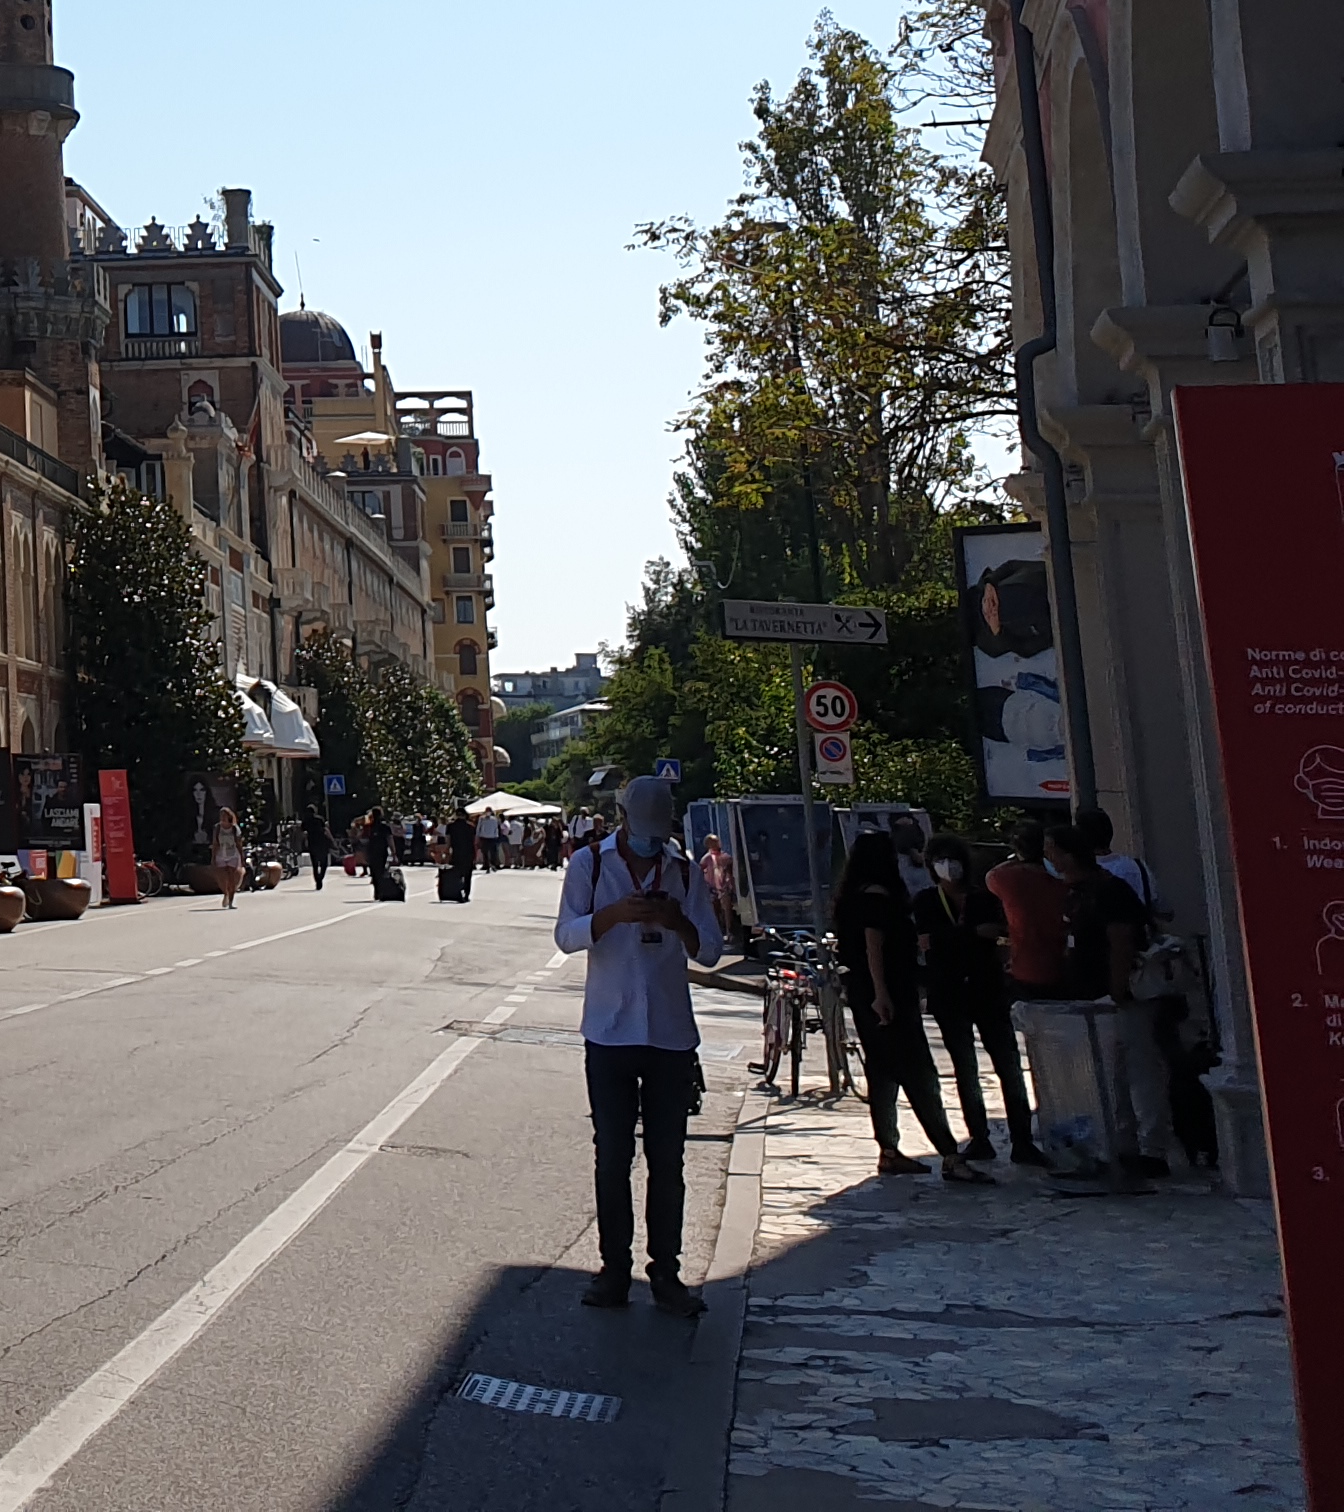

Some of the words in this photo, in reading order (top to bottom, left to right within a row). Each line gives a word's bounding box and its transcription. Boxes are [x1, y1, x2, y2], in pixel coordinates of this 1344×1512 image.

[1247, 647, 1306, 661] Norme
[1309, 647, 1326, 661] di
[1249, 664, 1284, 678] Anti
[1251, 682, 1286, 696] Anti
[815, 694, 846, 718] 50
[1253, 699, 1272, 714] of
[1302, 835, 1344, 850] Indo
